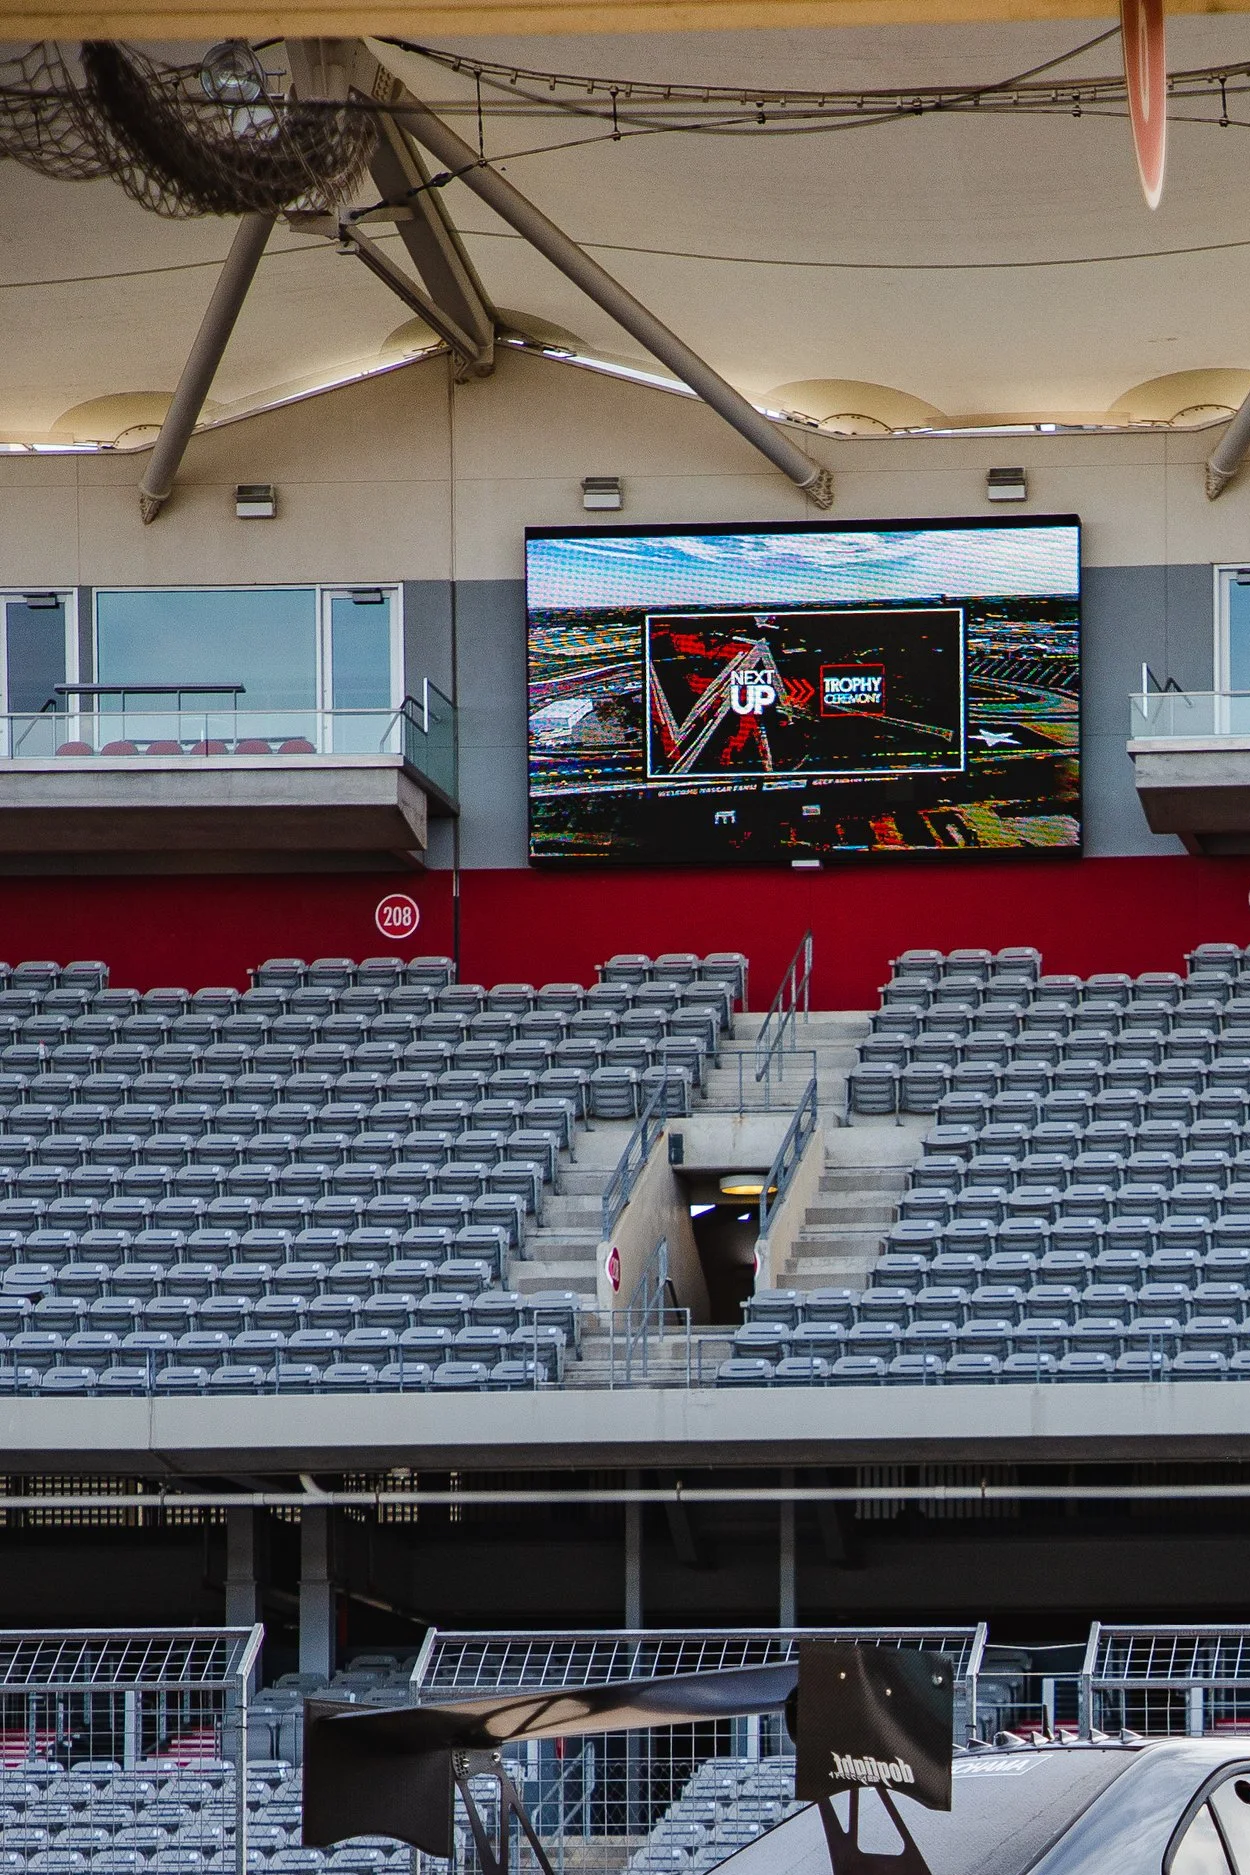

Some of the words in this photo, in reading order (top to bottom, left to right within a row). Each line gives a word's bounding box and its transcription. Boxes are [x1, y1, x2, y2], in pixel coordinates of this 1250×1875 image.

[731, 669, 775, 685] NEXT
[823, 677, 881, 692] TROPHY
[731, 685, 775, 715] UP
[824, 693, 881, 705] CEREMONY
[383, 906, 412, 927] 208
